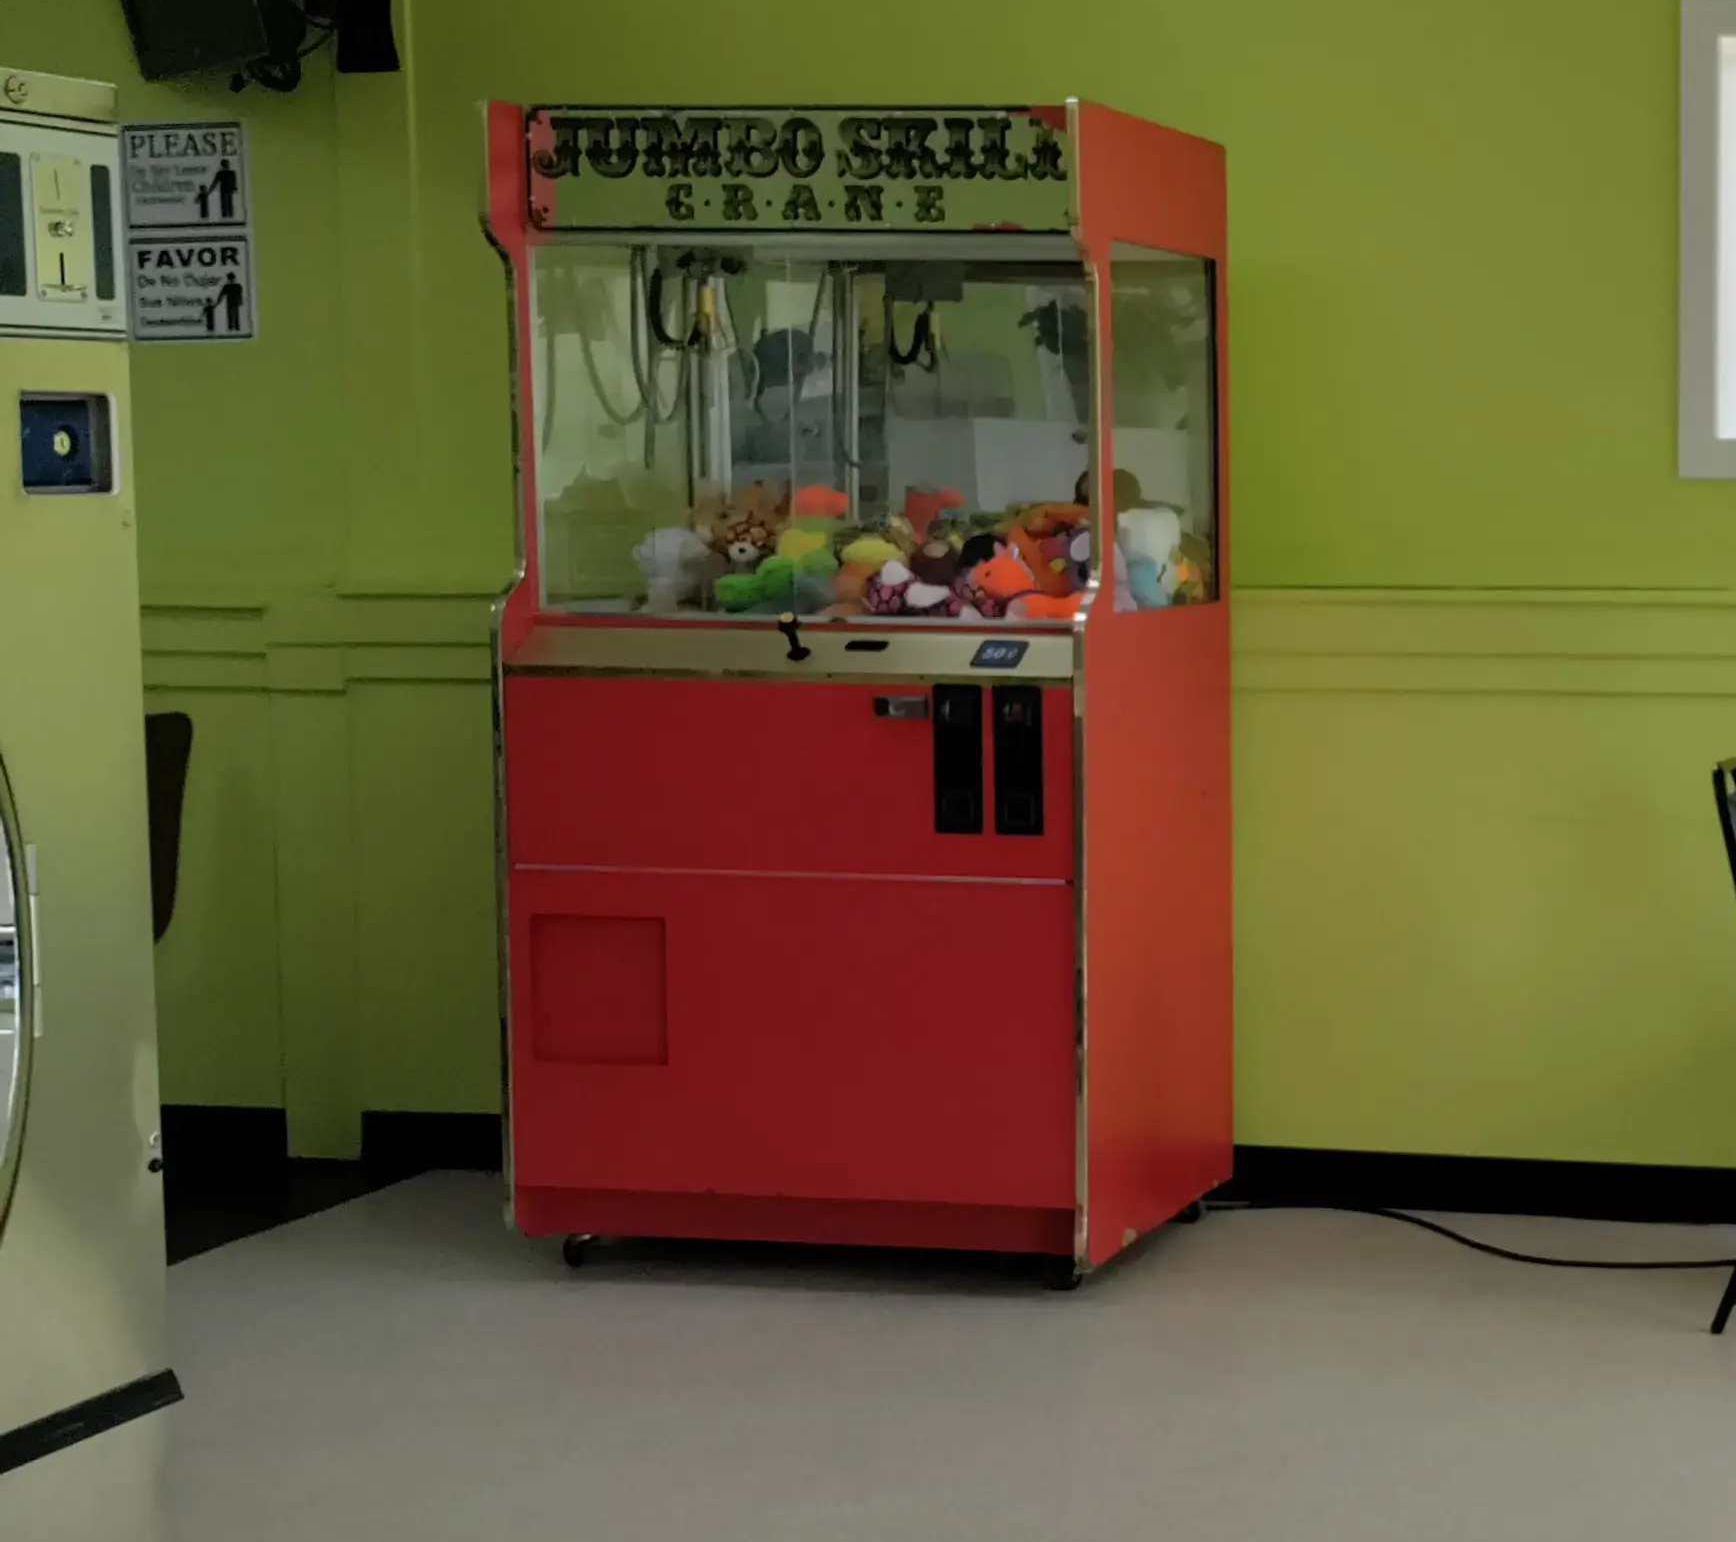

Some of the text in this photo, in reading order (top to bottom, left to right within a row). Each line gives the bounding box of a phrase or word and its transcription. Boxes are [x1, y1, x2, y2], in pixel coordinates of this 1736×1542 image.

[129, 131, 239, 159] PLEASE
[531, 116, 824, 178] JUMBO
[137, 247, 240, 269] FAVOR
